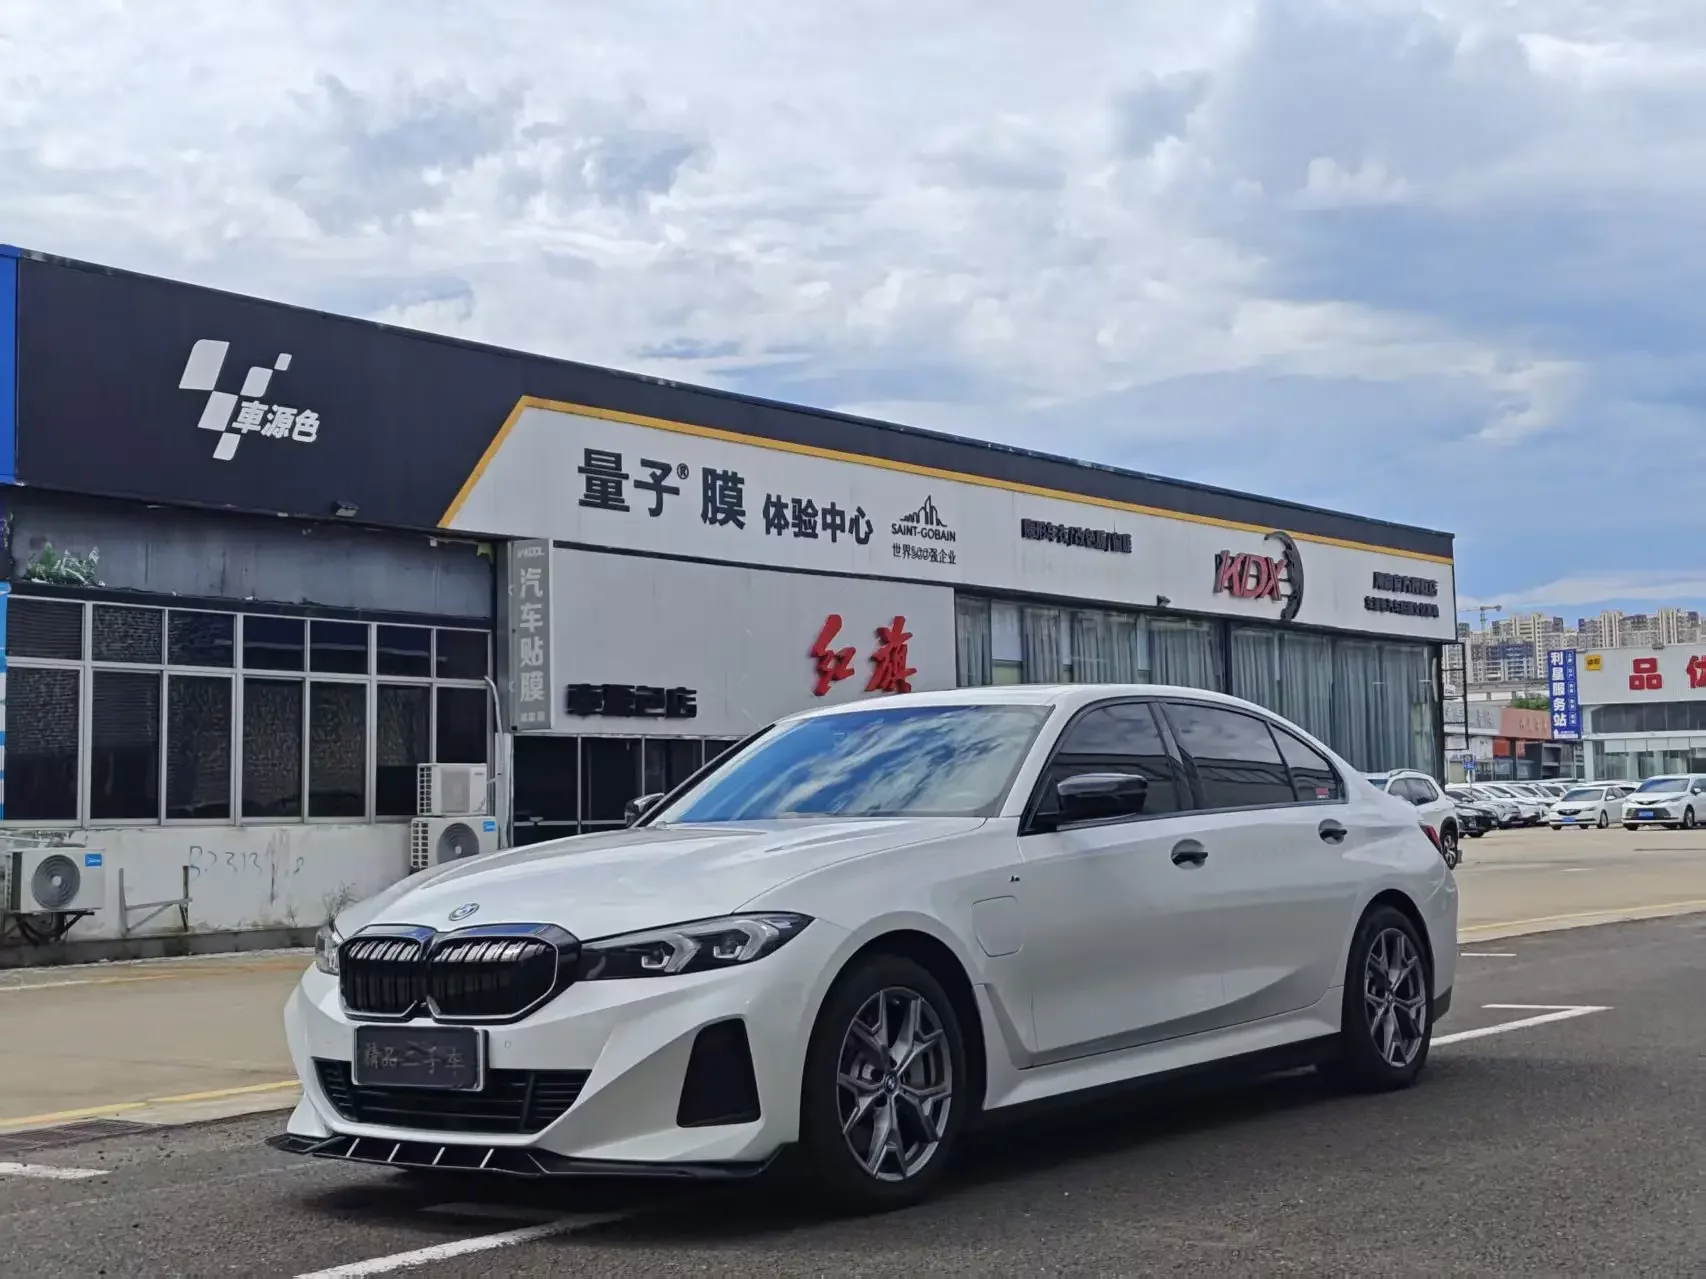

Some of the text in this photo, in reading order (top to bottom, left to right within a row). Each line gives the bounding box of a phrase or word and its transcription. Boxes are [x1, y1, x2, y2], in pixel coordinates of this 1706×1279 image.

[232, 400, 321, 443] 車源色
[762, 493, 874, 545] 体验中心
[891, 522, 956, 542] SAINT-GOBAIN
[892, 542, 956, 564] 世界500强企业
[1212, 549, 1288, 602] KDX
[519, 567, 545, 702] 汽车贴膜
[809, 613, 918, 697] 红旗
